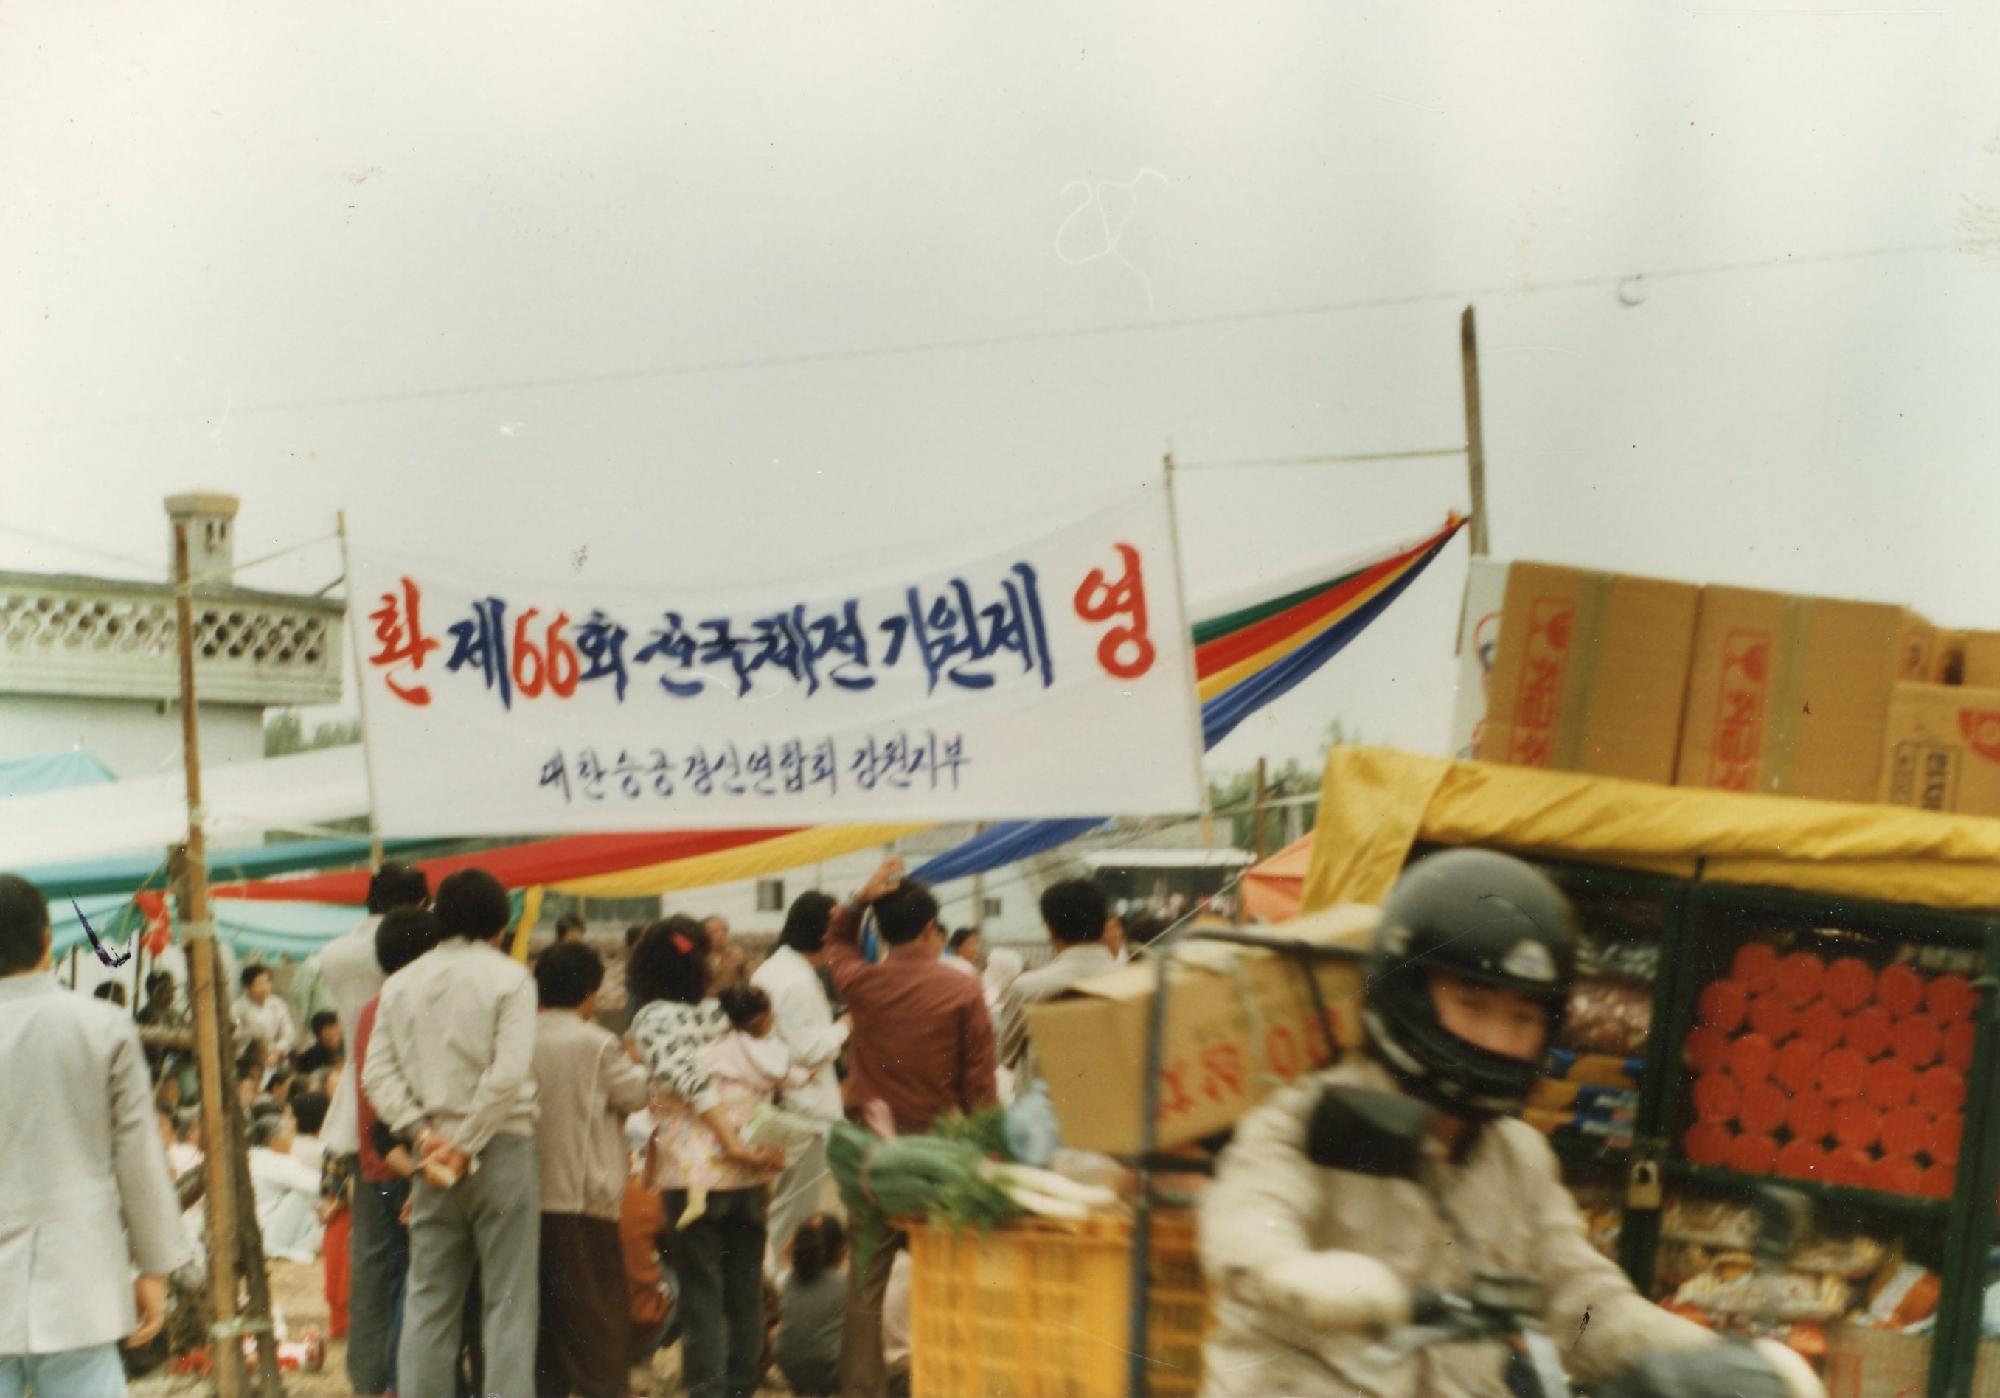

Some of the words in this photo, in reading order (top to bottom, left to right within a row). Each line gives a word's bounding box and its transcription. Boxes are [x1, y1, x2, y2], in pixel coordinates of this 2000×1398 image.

[368, 576, 441, 708] 환
[445, 597, 629, 712] 제66회
[878, 562, 1054, 693] 기원제
[1073, 542, 1157, 681] 영
